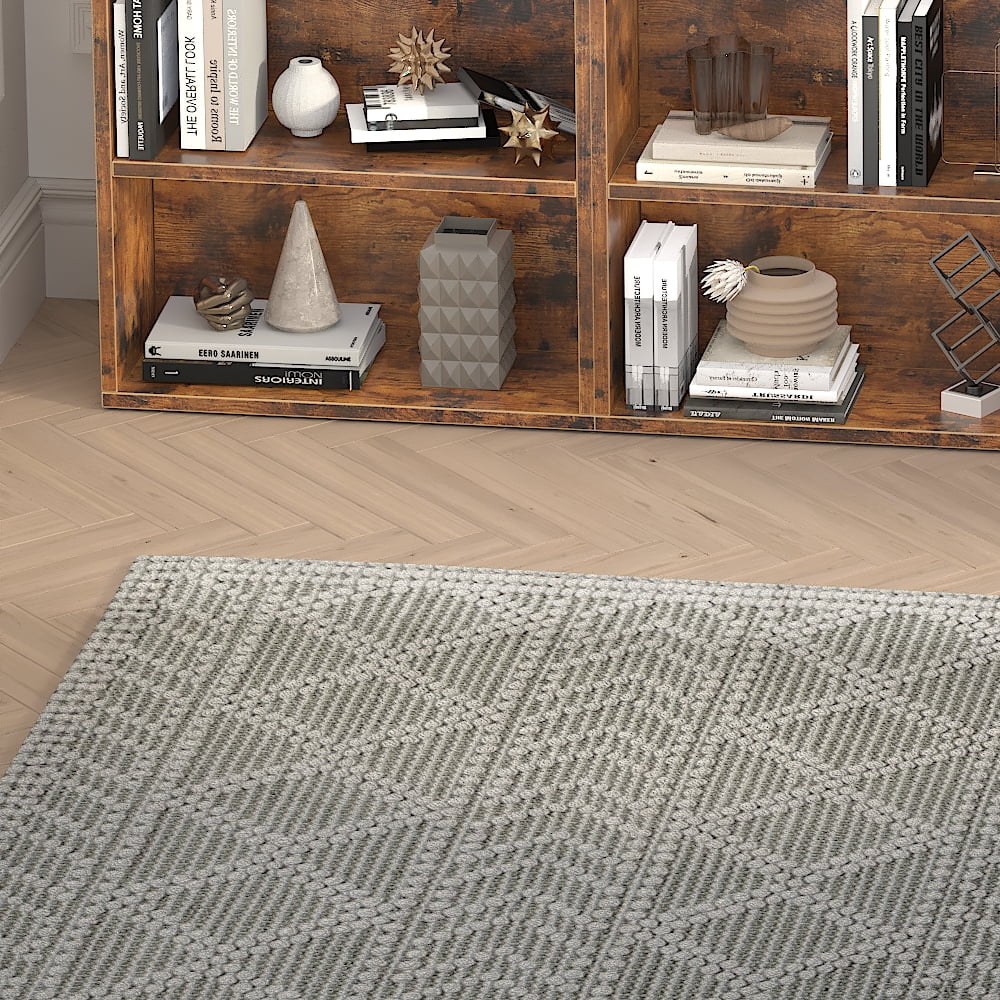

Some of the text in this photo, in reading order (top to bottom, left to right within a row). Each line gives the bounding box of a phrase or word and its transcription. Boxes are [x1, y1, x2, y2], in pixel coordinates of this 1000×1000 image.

[914, 25, 924, 54] BEST
[198, 349, 259, 359] EERO SAARINEN
[285, 370, 322, 378] NOW!
[254, 376, 323, 386] INTERIORS
